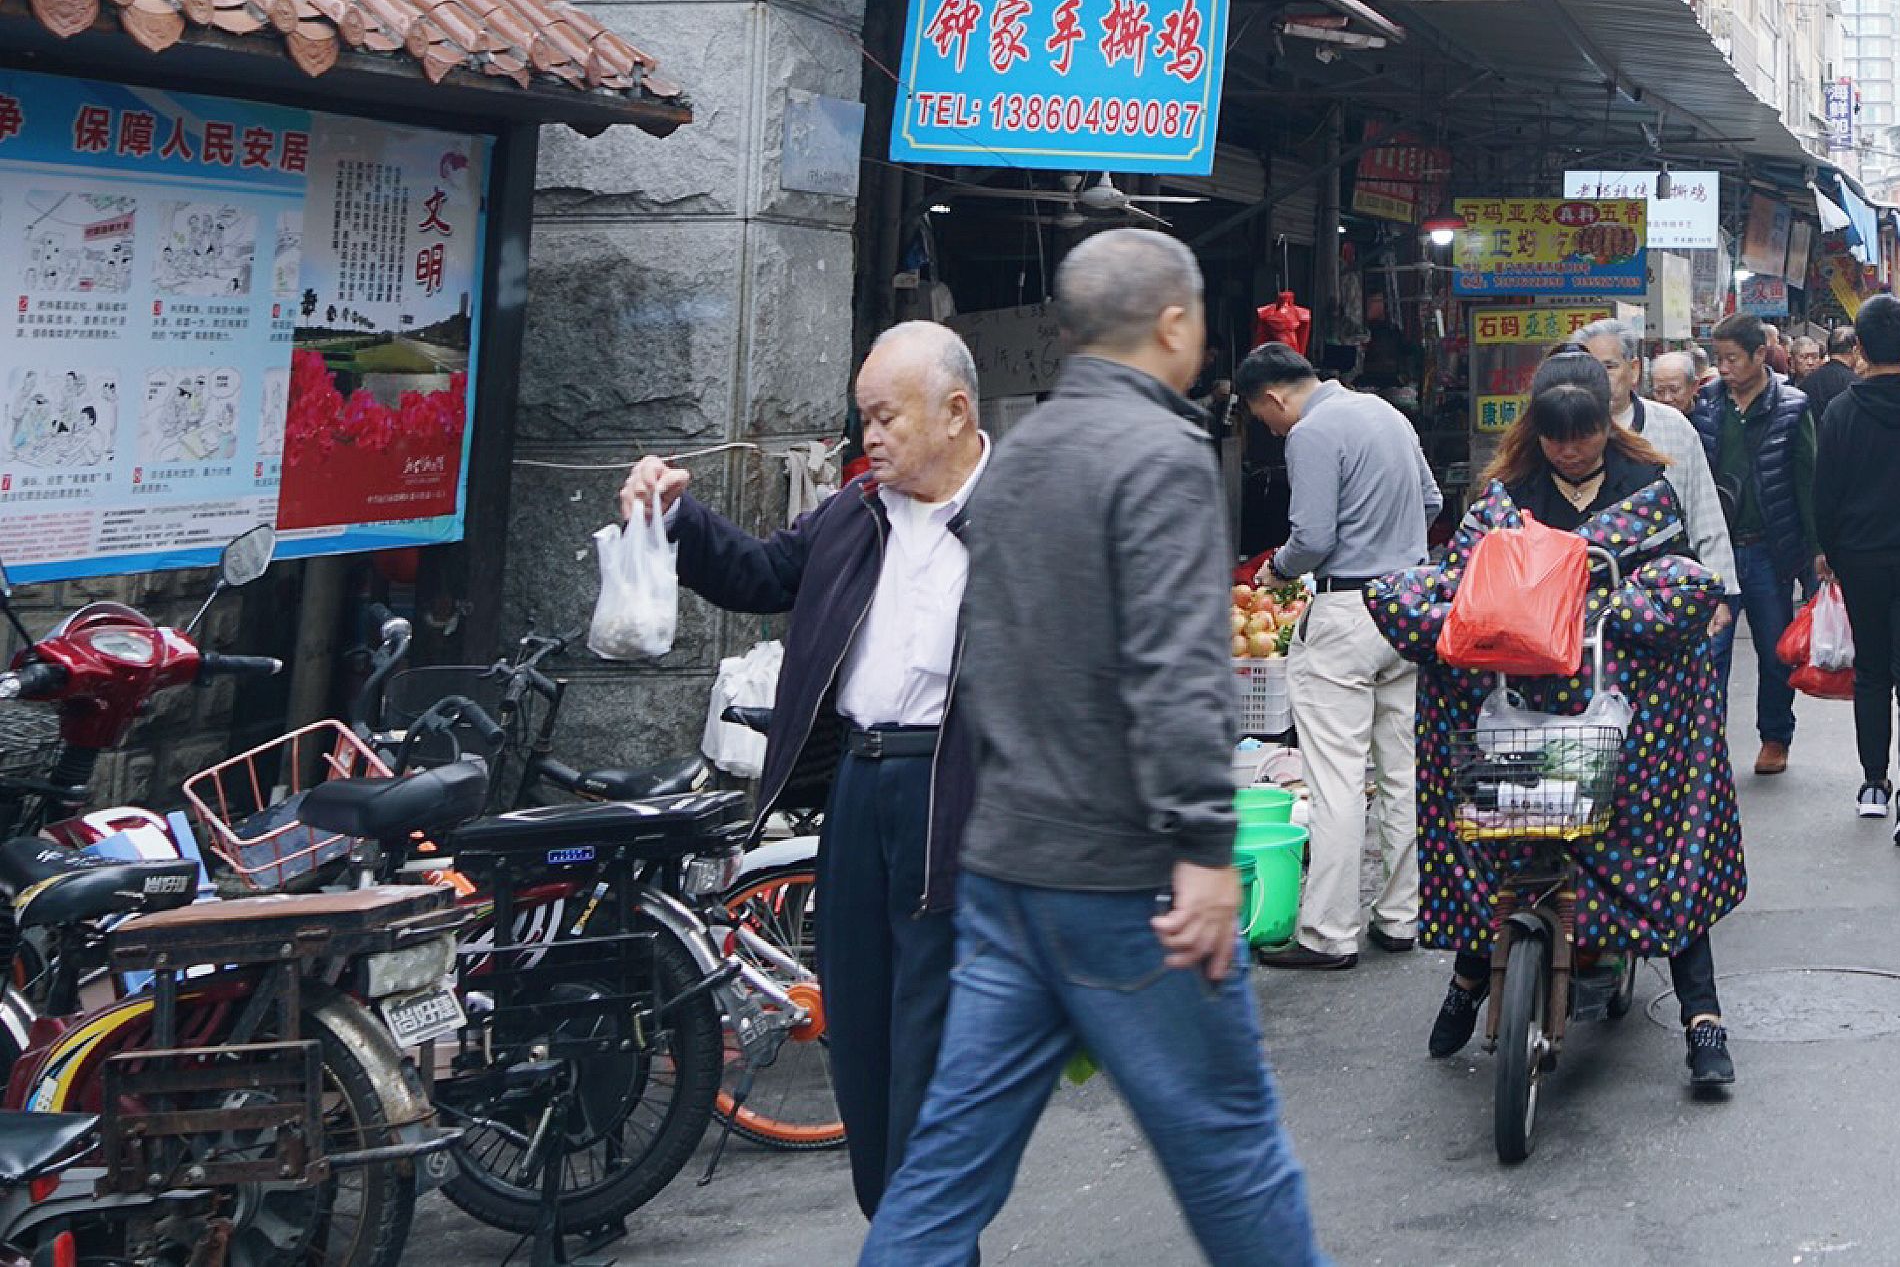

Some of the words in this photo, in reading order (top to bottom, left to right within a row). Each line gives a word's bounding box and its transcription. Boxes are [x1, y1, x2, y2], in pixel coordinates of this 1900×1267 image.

[75, 105, 310, 173] 保障人民安居
[917, 92, 982, 127] TEL:
[990, 93, 1203, 139] 13860499087
[417, 186, 451, 296] 文明
